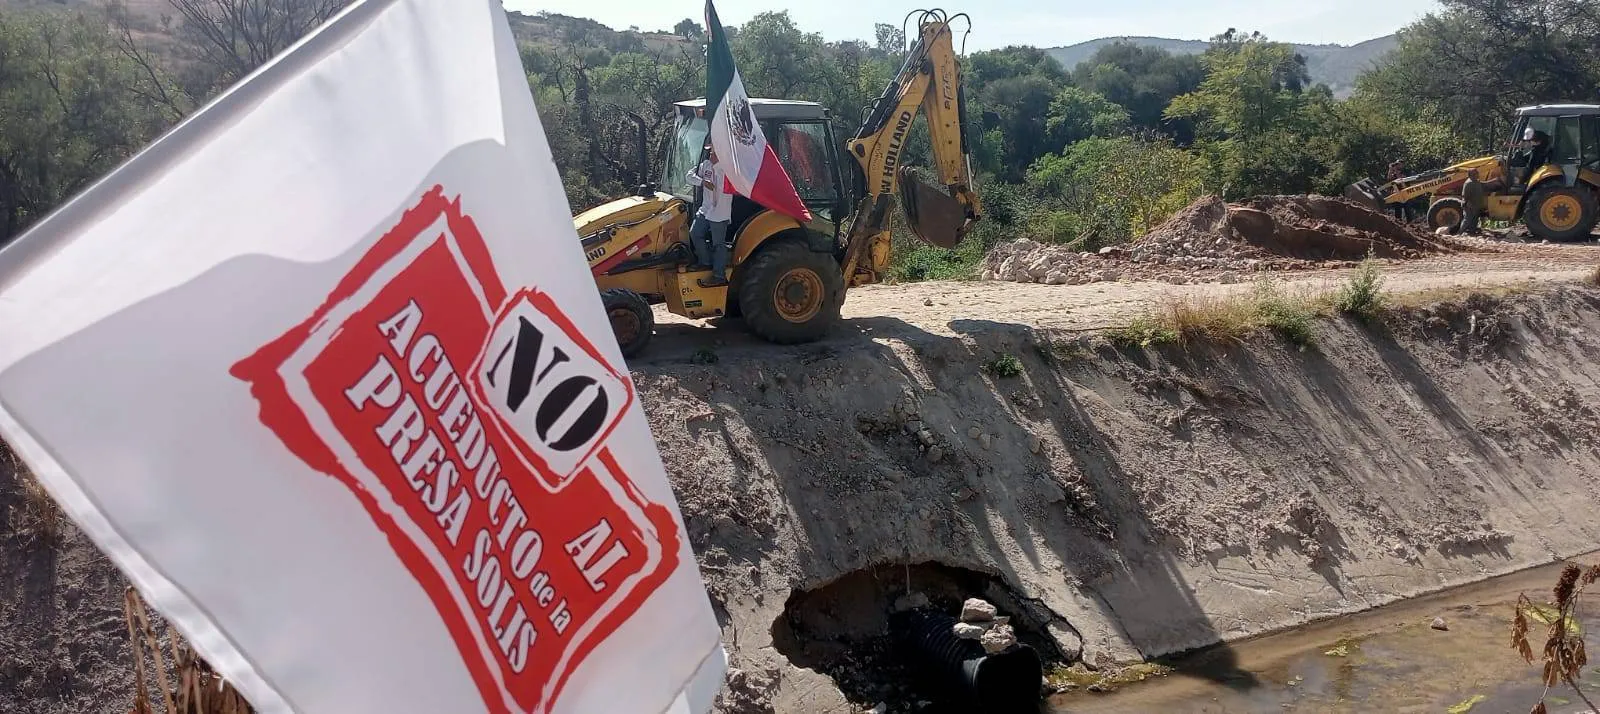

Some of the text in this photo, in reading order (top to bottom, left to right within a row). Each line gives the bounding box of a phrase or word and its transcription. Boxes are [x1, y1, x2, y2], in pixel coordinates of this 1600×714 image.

[883, 111, 911, 177] HOLLAND
[487, 315, 609, 452] NO
[343, 353, 537, 675] PRESA SOLIS
[376, 297, 573, 636] ACUEDUCTO de la
[564, 517, 630, 593] AL
